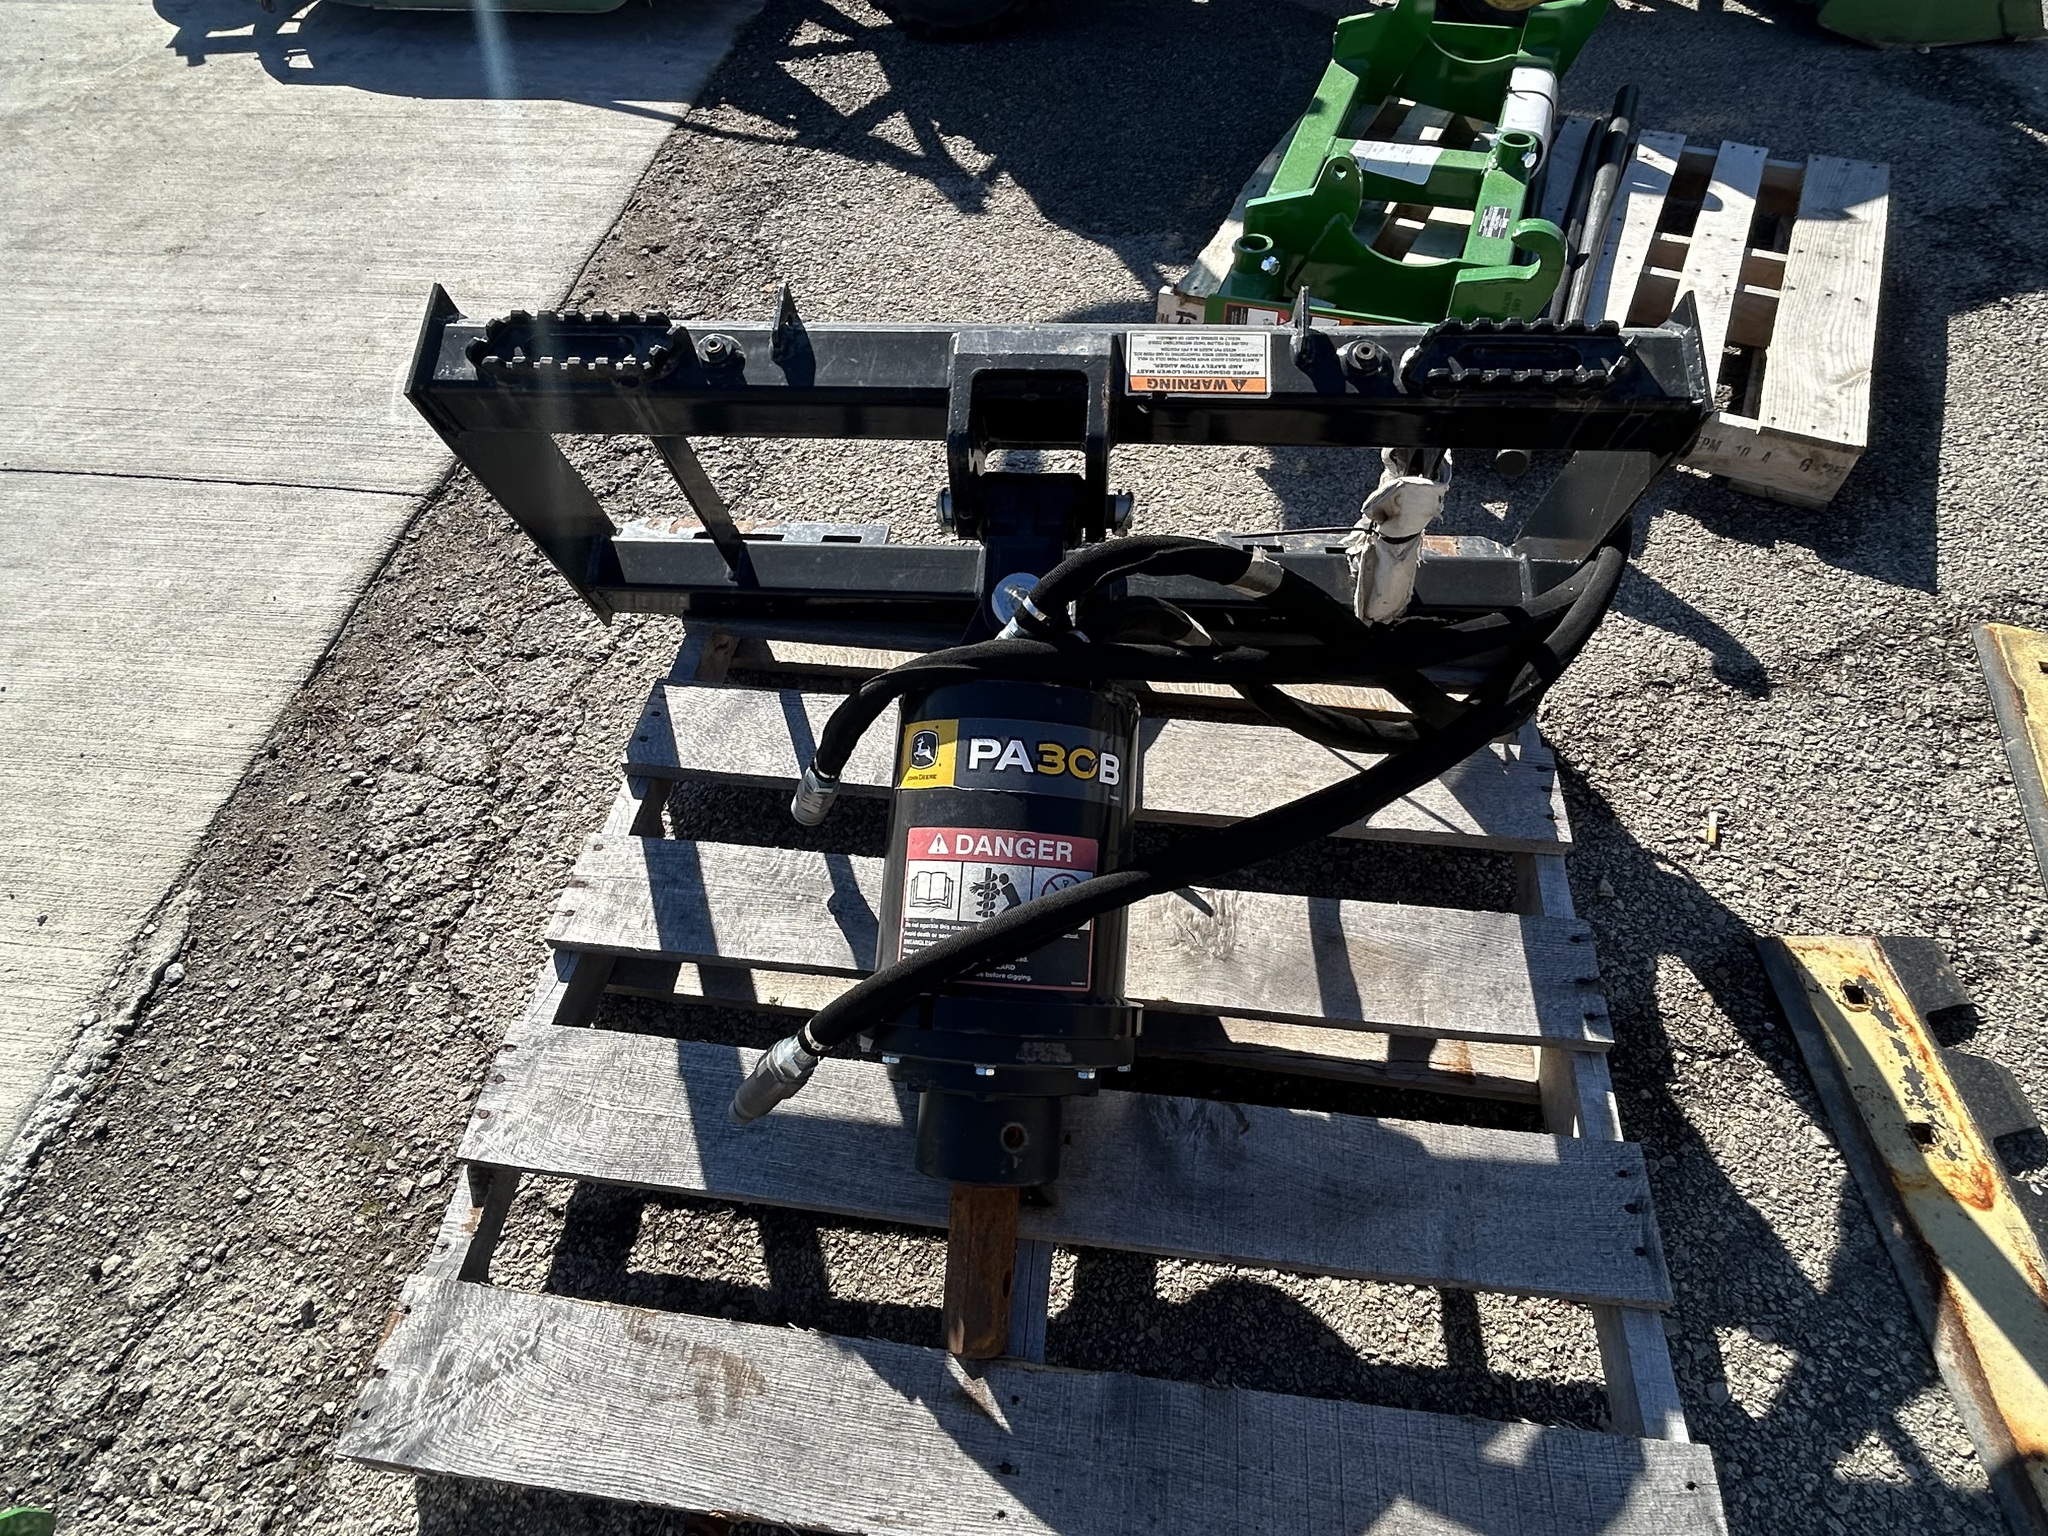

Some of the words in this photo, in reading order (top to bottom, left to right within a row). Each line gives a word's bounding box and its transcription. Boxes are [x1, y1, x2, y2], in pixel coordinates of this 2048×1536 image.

[1147, 379, 1228, 390] WARNING
[968, 738, 1120, 786] PA30B
[955, 834, 1073, 863] DANGER
